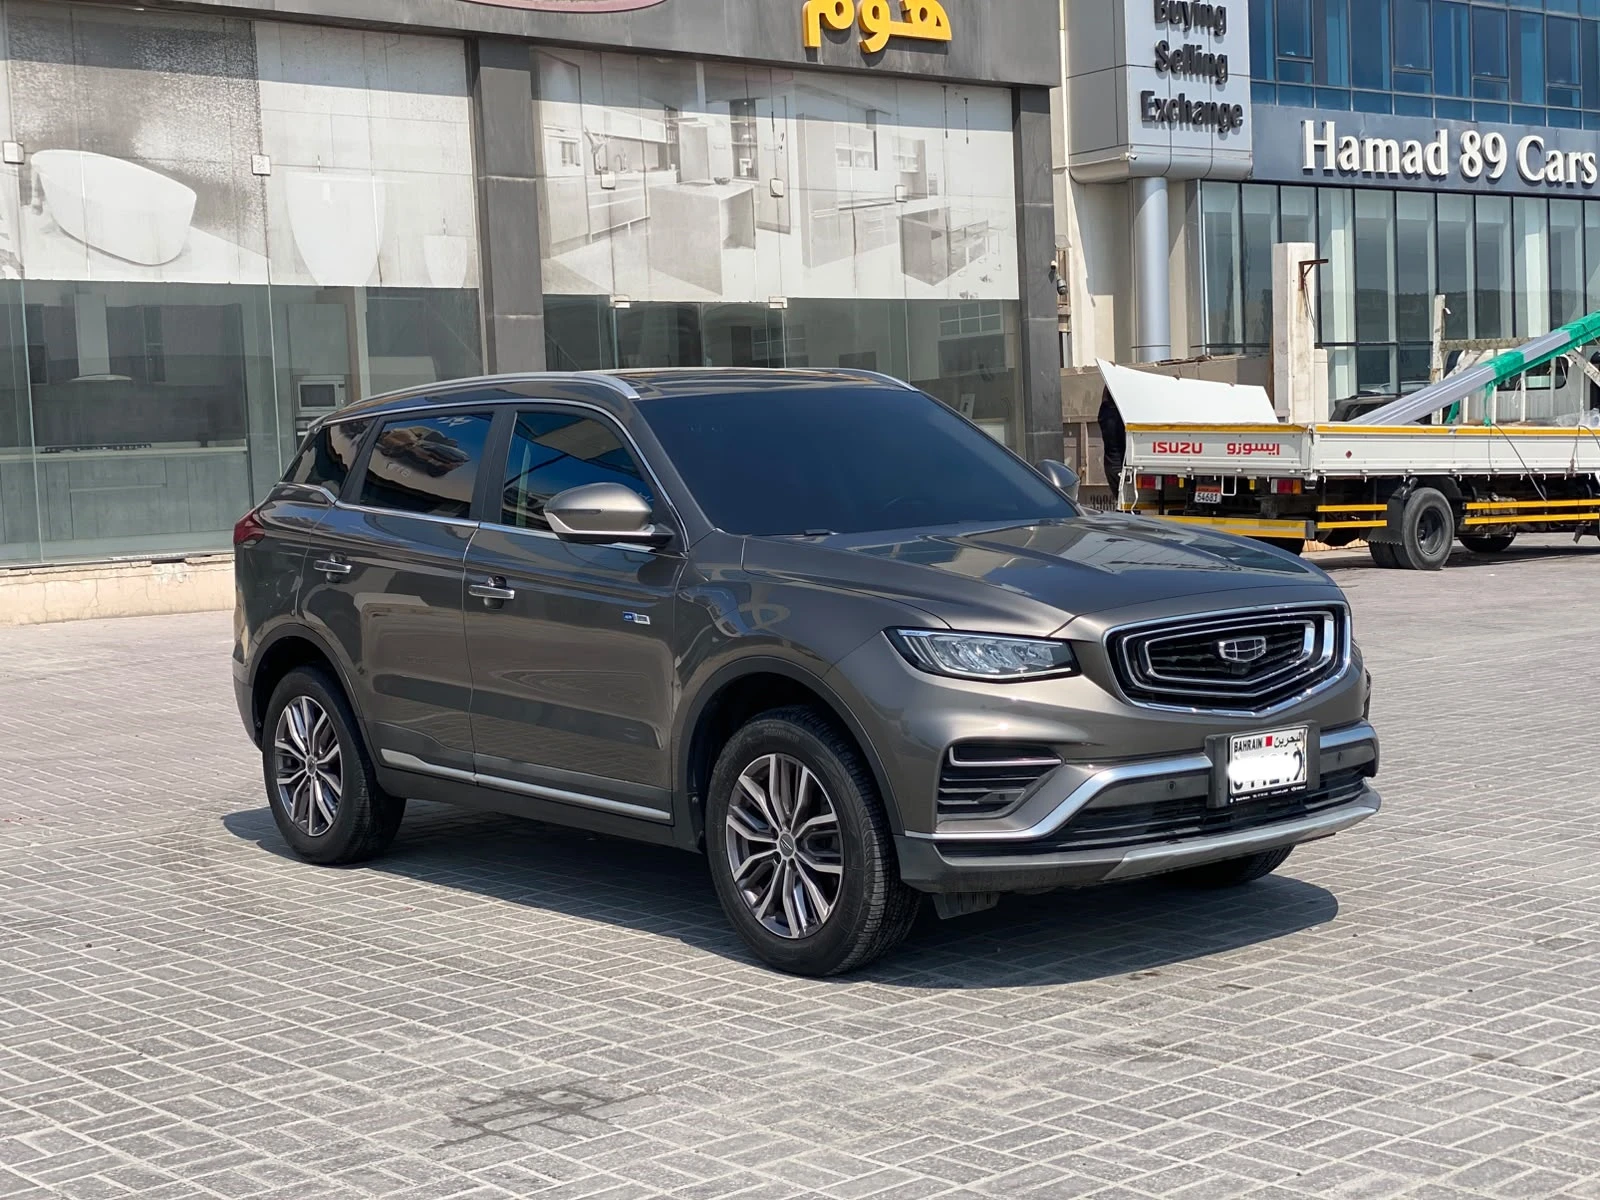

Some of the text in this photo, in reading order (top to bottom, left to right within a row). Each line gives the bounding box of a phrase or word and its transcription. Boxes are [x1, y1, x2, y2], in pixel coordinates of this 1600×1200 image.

[802, 0, 952, 53] هوم
[1154, 0, 1227, 36] Buying
[1155, 40, 1228, 85] Selling
[1141, 91, 1243, 133] Exchange
[1302, 119, 1598, 184] Hamad 89 Cars
[1152, 441, 1203, 454] ISUZU
[1234, 738, 1263, 752] BAHRAIN
